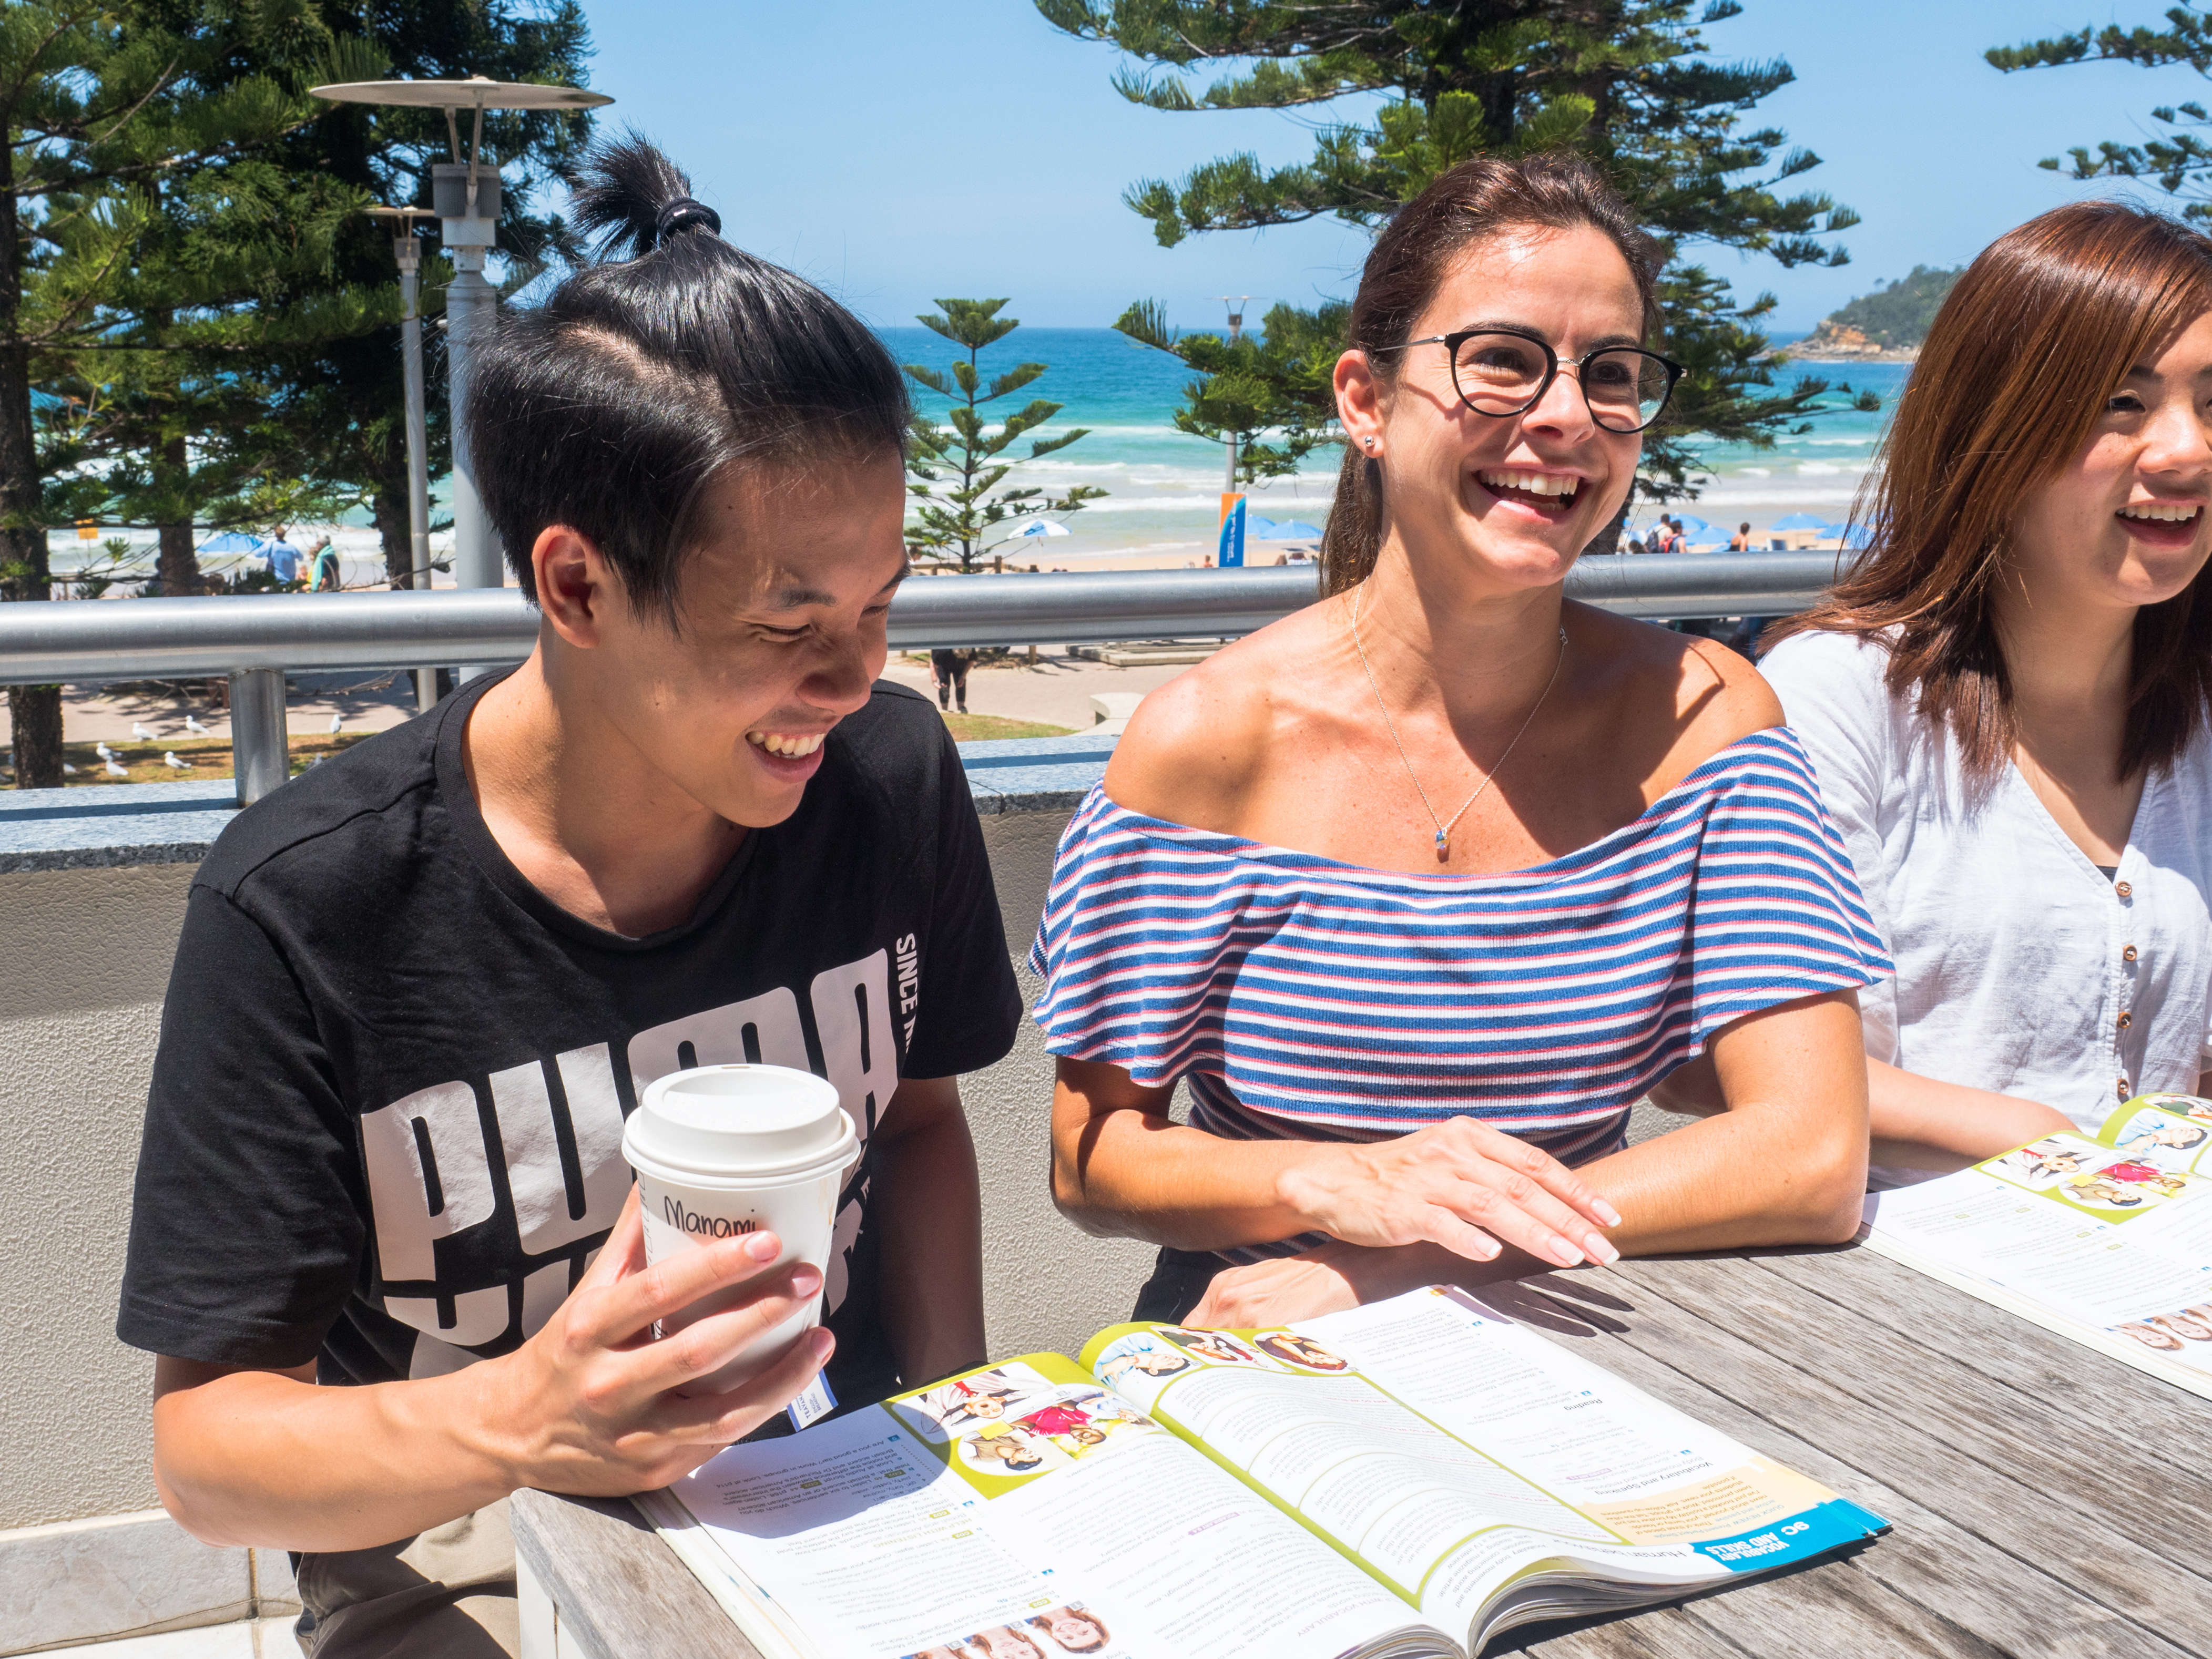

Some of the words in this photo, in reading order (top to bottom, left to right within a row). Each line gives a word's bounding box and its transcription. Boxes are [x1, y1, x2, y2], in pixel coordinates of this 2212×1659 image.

[896, 933, 918, 1015] SINCE
[664, 1195, 756, 1238] Manami
[810, 1392, 822, 1411] BREAKFAST
[1564, 1398, 1603, 1411] Reading
[833, 1451, 852, 1460] good
[871, 1448, 894, 1458] British
[847, 1456, 871, 1466] accent
[862, 1457, 884, 1466] notice
[1681, 1456, 1704, 1465] Body
[844, 1468, 866, 1476] Audio
[894, 1462, 910, 1472] hear
[1638, 1463, 1682, 1478] movements
[1659, 1461, 1714, 1480] Vocabulary
[784, 1470, 822, 1482] Richards's
[813, 1468, 849, 1481] difference
[823, 1472, 845, 1483] Script
[847, 1474, 870, 1483] British
[748, 1480, 783, 1491] American
[782, 1477, 816, 1489] between
[821, 1481, 846, 1491] accent
[850, 1479, 872, 1488] Listen
[1583, 1480, 1623, 1490] responses
[1640, 1478, 1659, 1487] and
[1714, 1480, 1744, 1493] students
[862, 1489, 886, 1498] mother
[1594, 1483, 1641, 1495] Speaking
[1734, 1485, 1752, 1493] been
[767, 1493, 801, 1506] American
[1734, 1493, 1747, 1501] just
[1749, 1494, 1768, 1503] news
[1708, 1499, 1735, 1510] booked
[1729, 1501, 1749, 1511] about
[1755, 1499, 1776, 1509] active
[1760, 1504, 1785, 1515] QUICK
[940, 1513, 966, 1523] British
[1715, 1511, 1741, 1522] passive
[1732, 1513, 1761, 1525] REVIEW
[949, 1518, 972, 1528] HELP
[1703, 1523, 1732, 1532] Present
[1780, 1521, 1810, 1535] 9C
[884, 1525, 922, 1538] American
[923, 1526, 947, 1535] WITH
[952, 1529, 974, 1538] CD2
[850, 1536, 883, 1549] accents
[873, 1533, 922, 1548] LISTENING
[915, 1540, 939, 1549] Listen
[1748, 1532, 1779, 1547] AND
[1552, 1538, 1628, 1556] behaviour
[1705, 1541, 1752, 1554] SKILLS
[1717, 1540, 1790, 1561] VOCABULARY
[867, 1553, 892, 1563] Check
[1358, 1597, 1384, 1606] WITH
[1297, 1603, 1359, 1637] VOCABULARY
